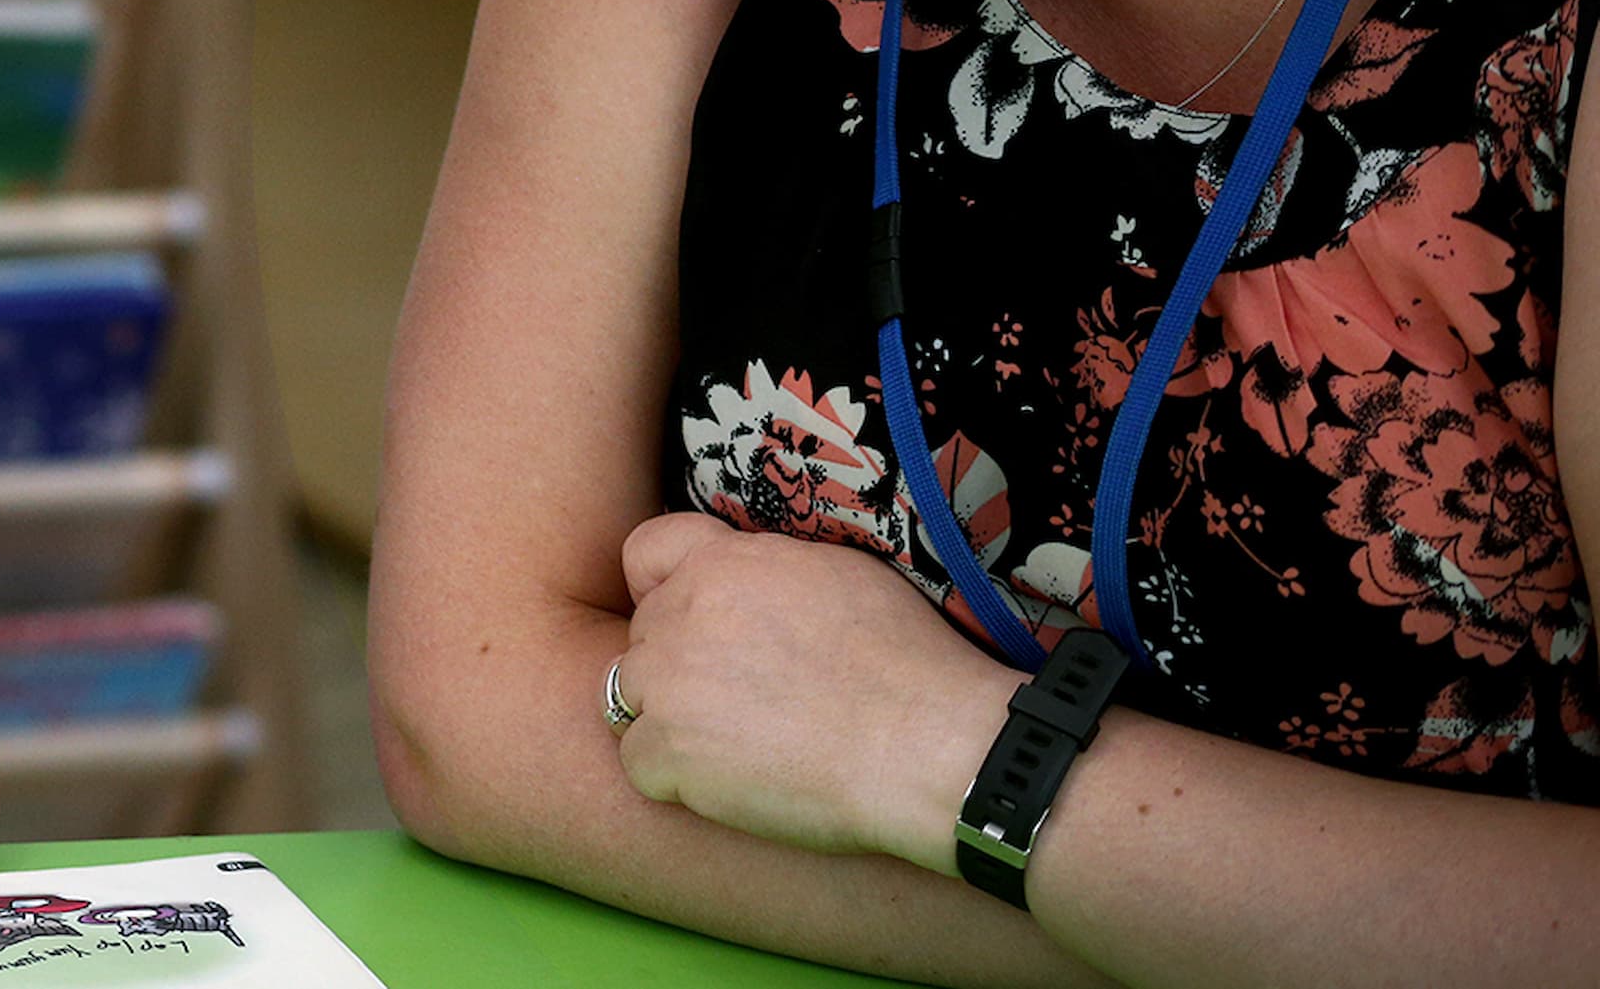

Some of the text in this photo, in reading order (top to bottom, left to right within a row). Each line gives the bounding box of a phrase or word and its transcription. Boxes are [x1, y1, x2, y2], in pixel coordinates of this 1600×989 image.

[47, 944, 92, 958] Yum
[96, 939, 190, 954] Lap lap
[9, 950, 48, 968] yum
